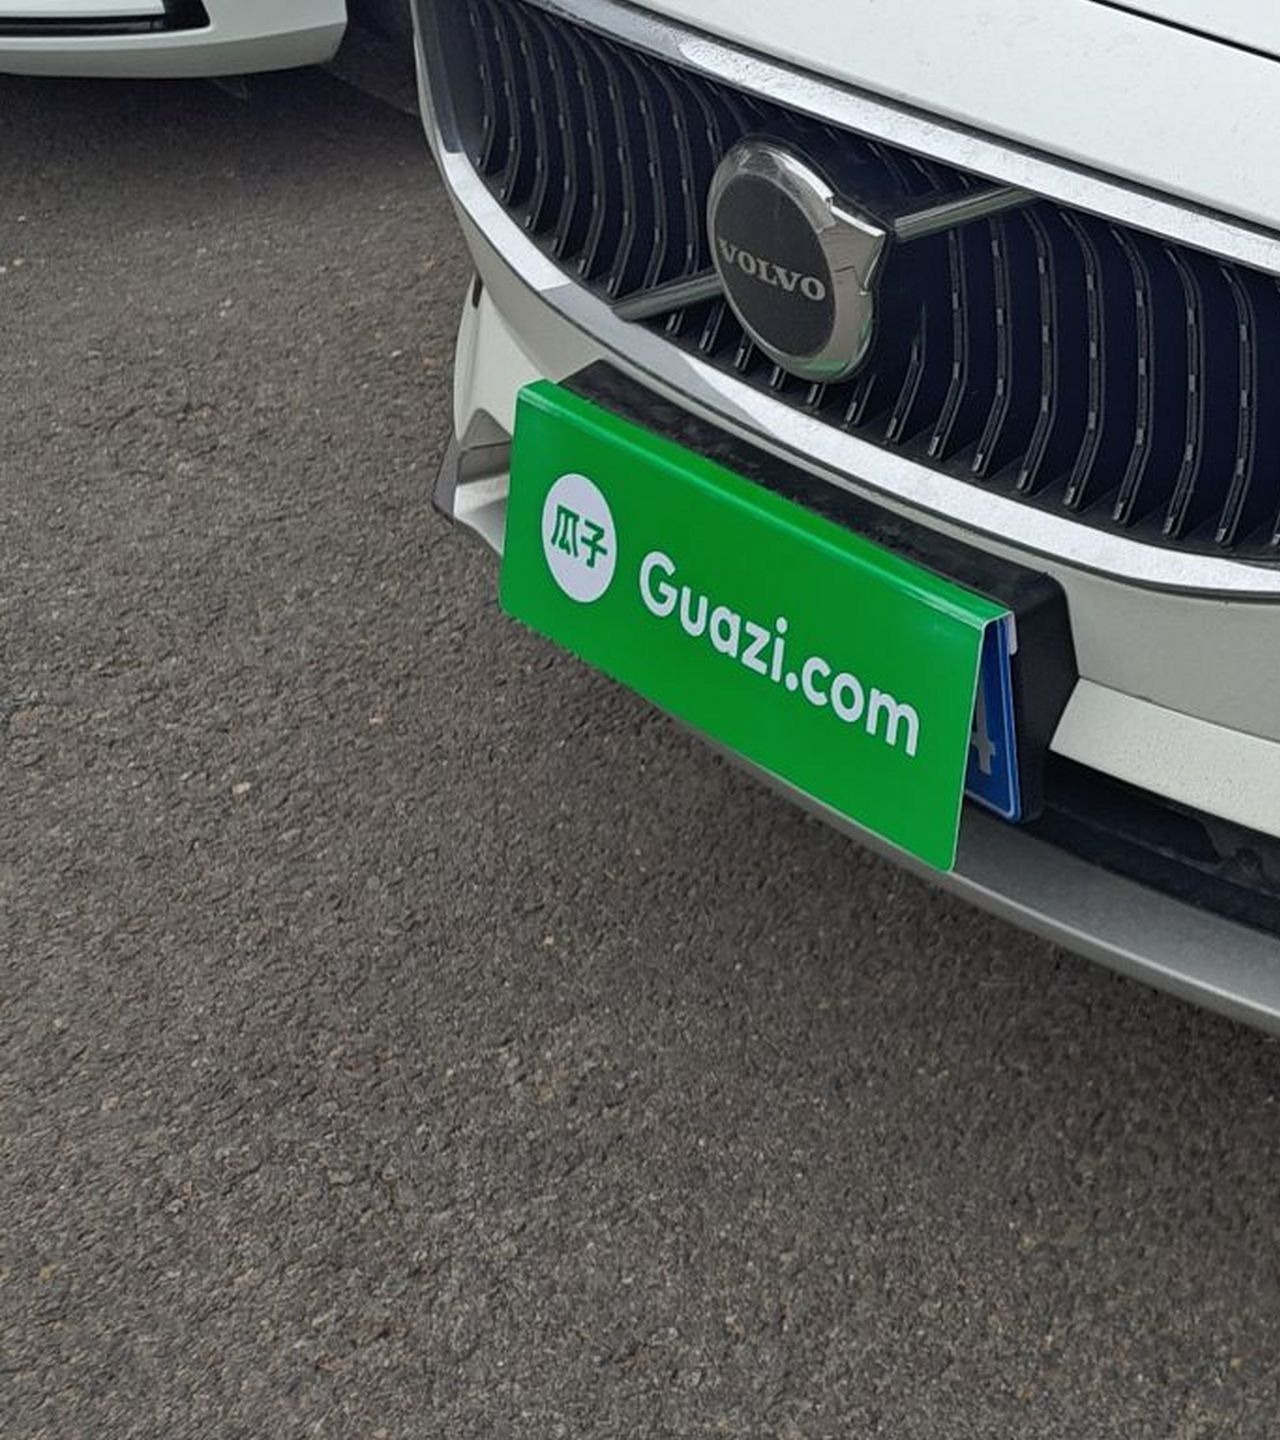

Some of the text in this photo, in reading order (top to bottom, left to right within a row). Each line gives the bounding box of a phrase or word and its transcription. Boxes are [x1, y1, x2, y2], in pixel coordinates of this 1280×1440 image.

[719, 238, 826, 301] VOLVO
[551, 504, 920, 758] 瓜子 Guazi.com
